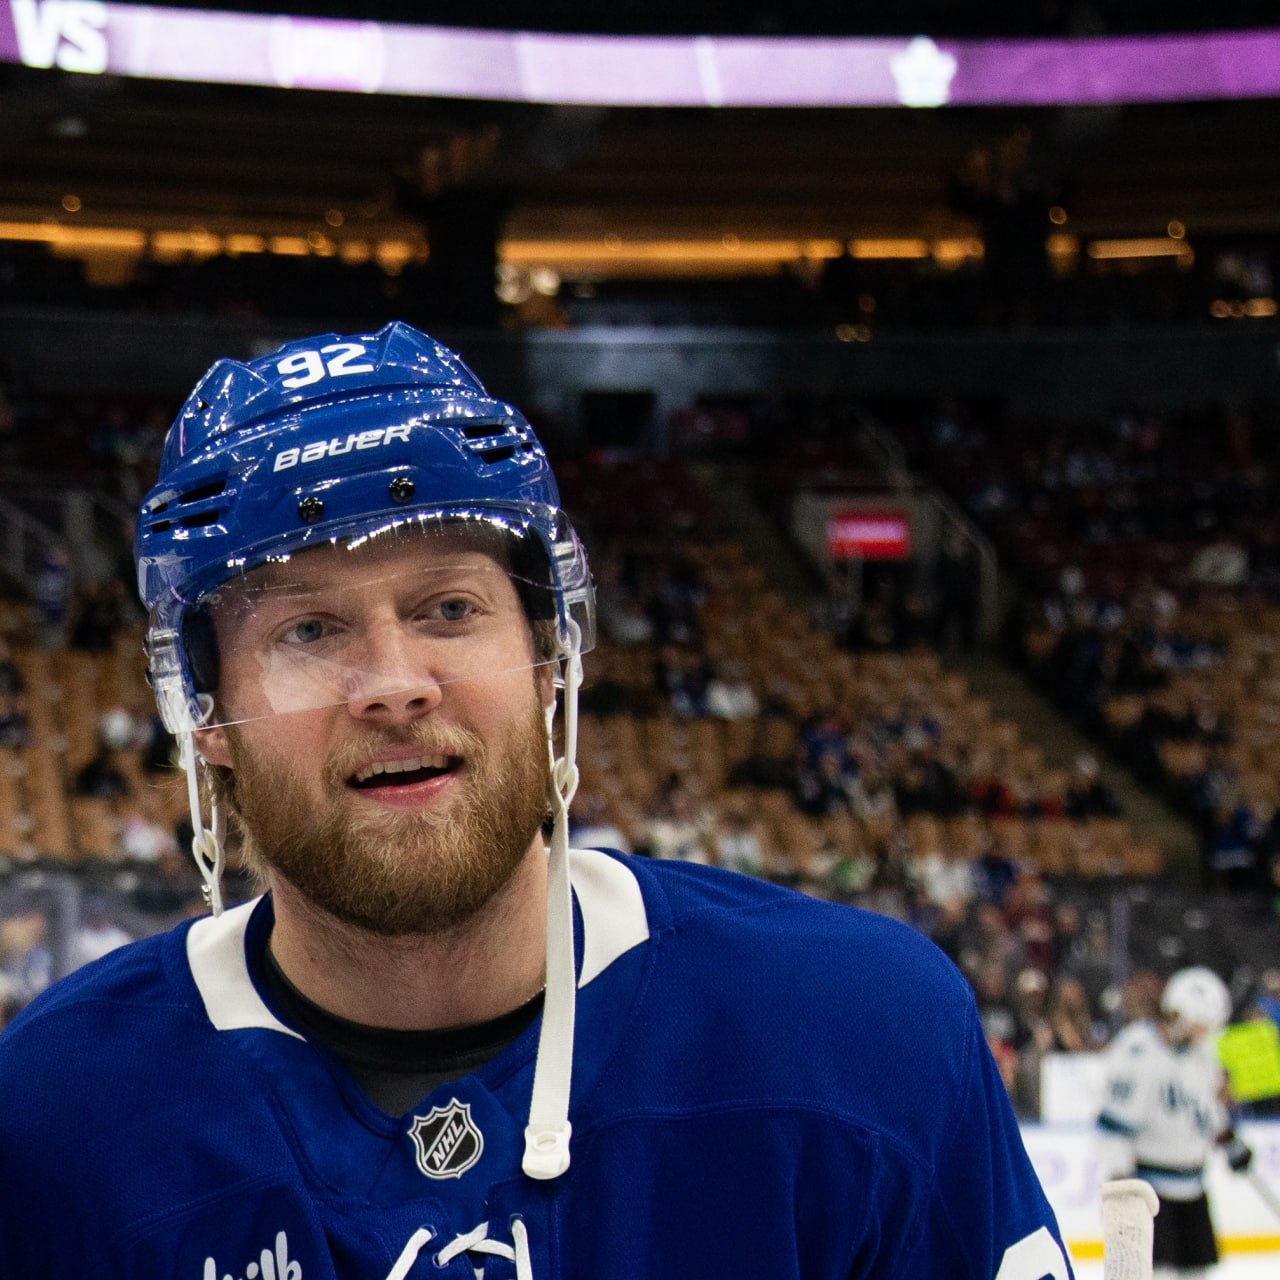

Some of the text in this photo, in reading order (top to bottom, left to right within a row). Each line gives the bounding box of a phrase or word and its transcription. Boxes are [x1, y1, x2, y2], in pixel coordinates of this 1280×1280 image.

[10, 0, 108, 74] VS
[276, 343, 374, 388] 92
[431, 1118, 464, 1167] NHL
